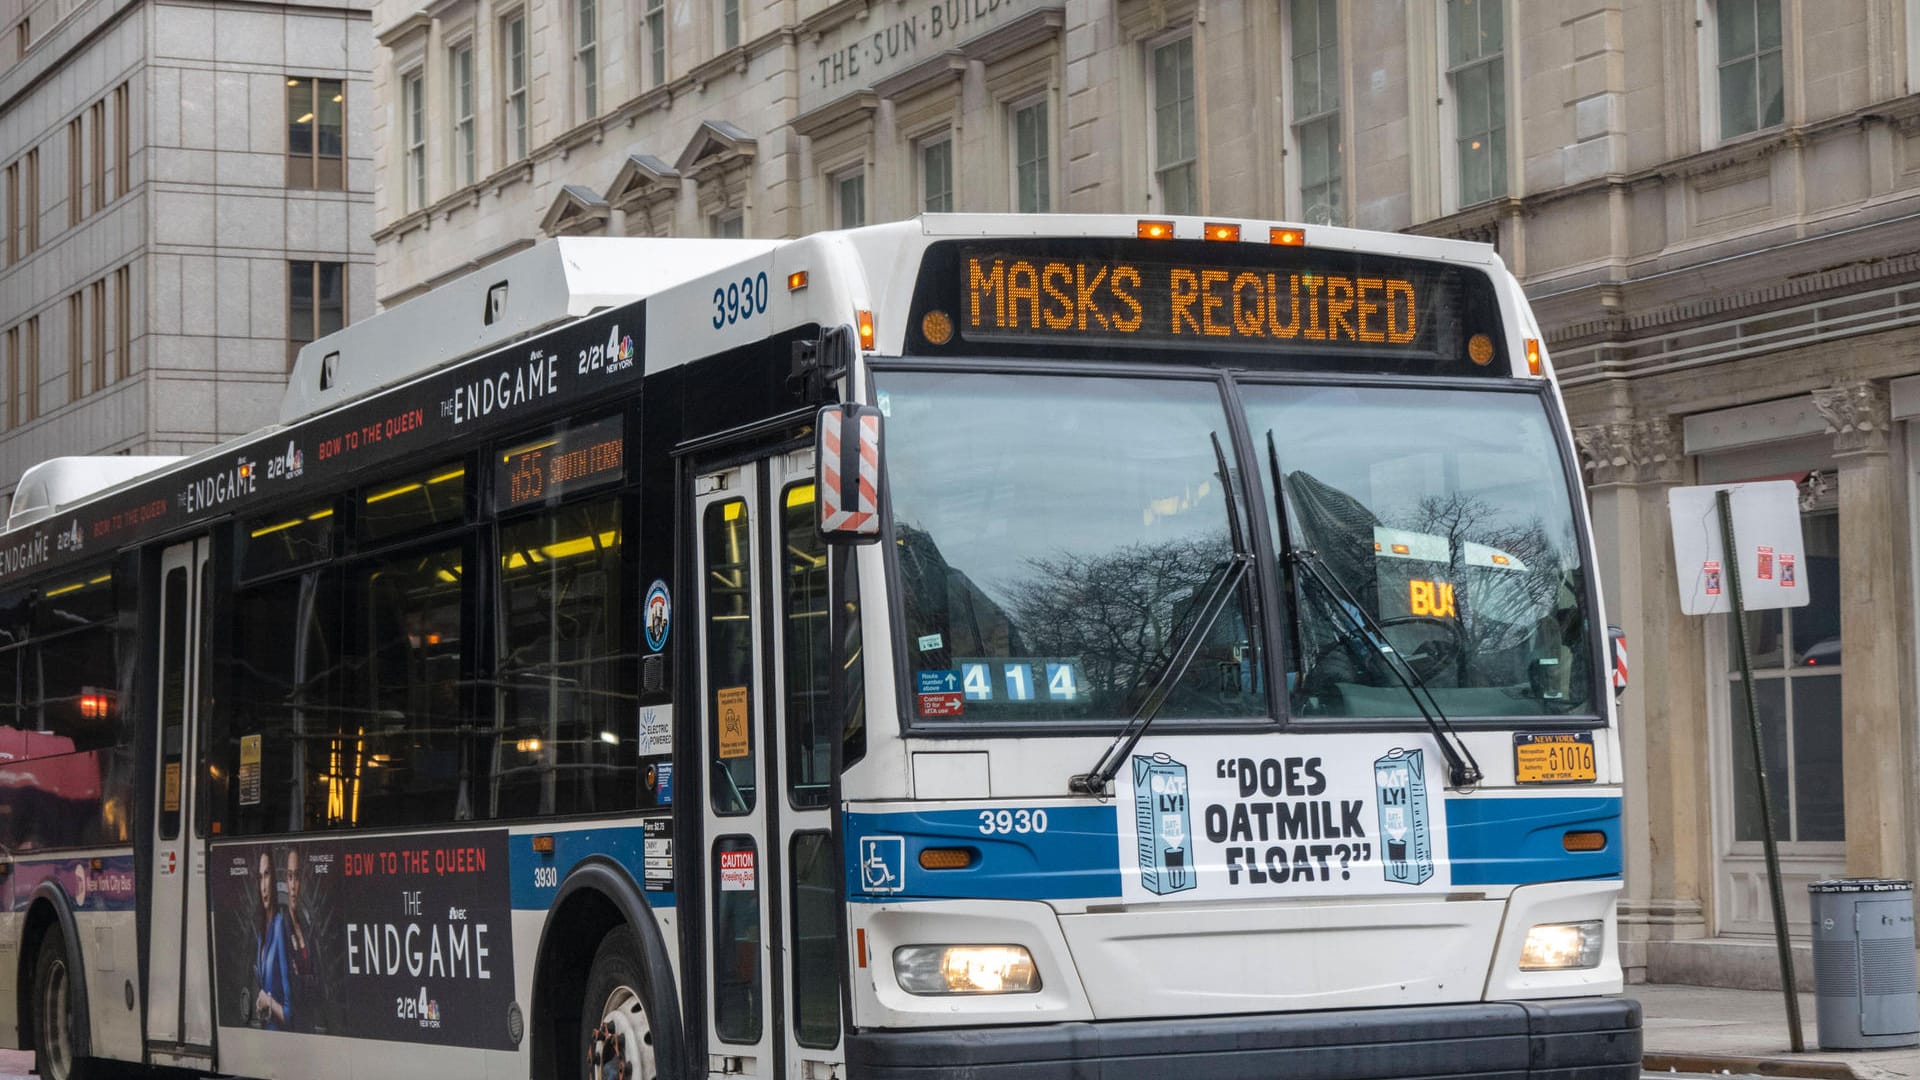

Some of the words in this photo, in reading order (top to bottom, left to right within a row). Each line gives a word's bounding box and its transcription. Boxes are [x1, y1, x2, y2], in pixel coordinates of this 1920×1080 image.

[819, 44, 860, 88] THE
[874, 16, 917, 65] SUN
[713, 271, 768, 330] 3930
[969, 258, 1143, 332] MASKS
[1171, 268, 1417, 344] REQUIRED
[578, 344, 604, 375] 2/21
[606, 324, 619, 363] 4
[606, 364, 618, 374] NEW
[618, 359, 634, 371] YORK
[440, 398, 453, 418] THE
[454, 355, 558, 424] ENDGAME
[319, 437, 342, 460] BOW
[345, 431, 358, 451] TO
[362, 422, 382, 446] THE
[386, 408, 423, 440] QUEEN
[267, 455, 285, 479] 2/21
[286, 440, 295, 471] 4
[550, 449, 587, 484] SOUTH
[187, 462, 256, 514] ENDGAME
[963, 664, 990, 700] 4
[1006, 665, 1026, 700] 1
[1049, 665, 1077, 700] 4
[647, 724, 669, 735] ELECTRIC
[1534, 735, 1553, 744] NEW
[1555, 735, 1575, 744] YORK
[1159, 794, 1184, 812] LY!
[1383, 787, 1406, 805] LY!
[978, 809, 1048, 835] 3930
[1205, 800, 1366, 843] OATMILK
[344, 853, 374, 876] BOW
[380, 852, 397, 875] TO
[402, 850, 430, 875] THE
[435, 848, 486, 876] QUEEN
[534, 866, 557, 888] 3930
[721, 854, 753, 868] CAUTION
[402, 891, 422, 916] THE
[347, 923, 491, 979] ENDGAME
[397, 997, 417, 1020] 2/21
[418, 986, 428, 1019] 4
[428, 1019, 440, 1028] YORK
